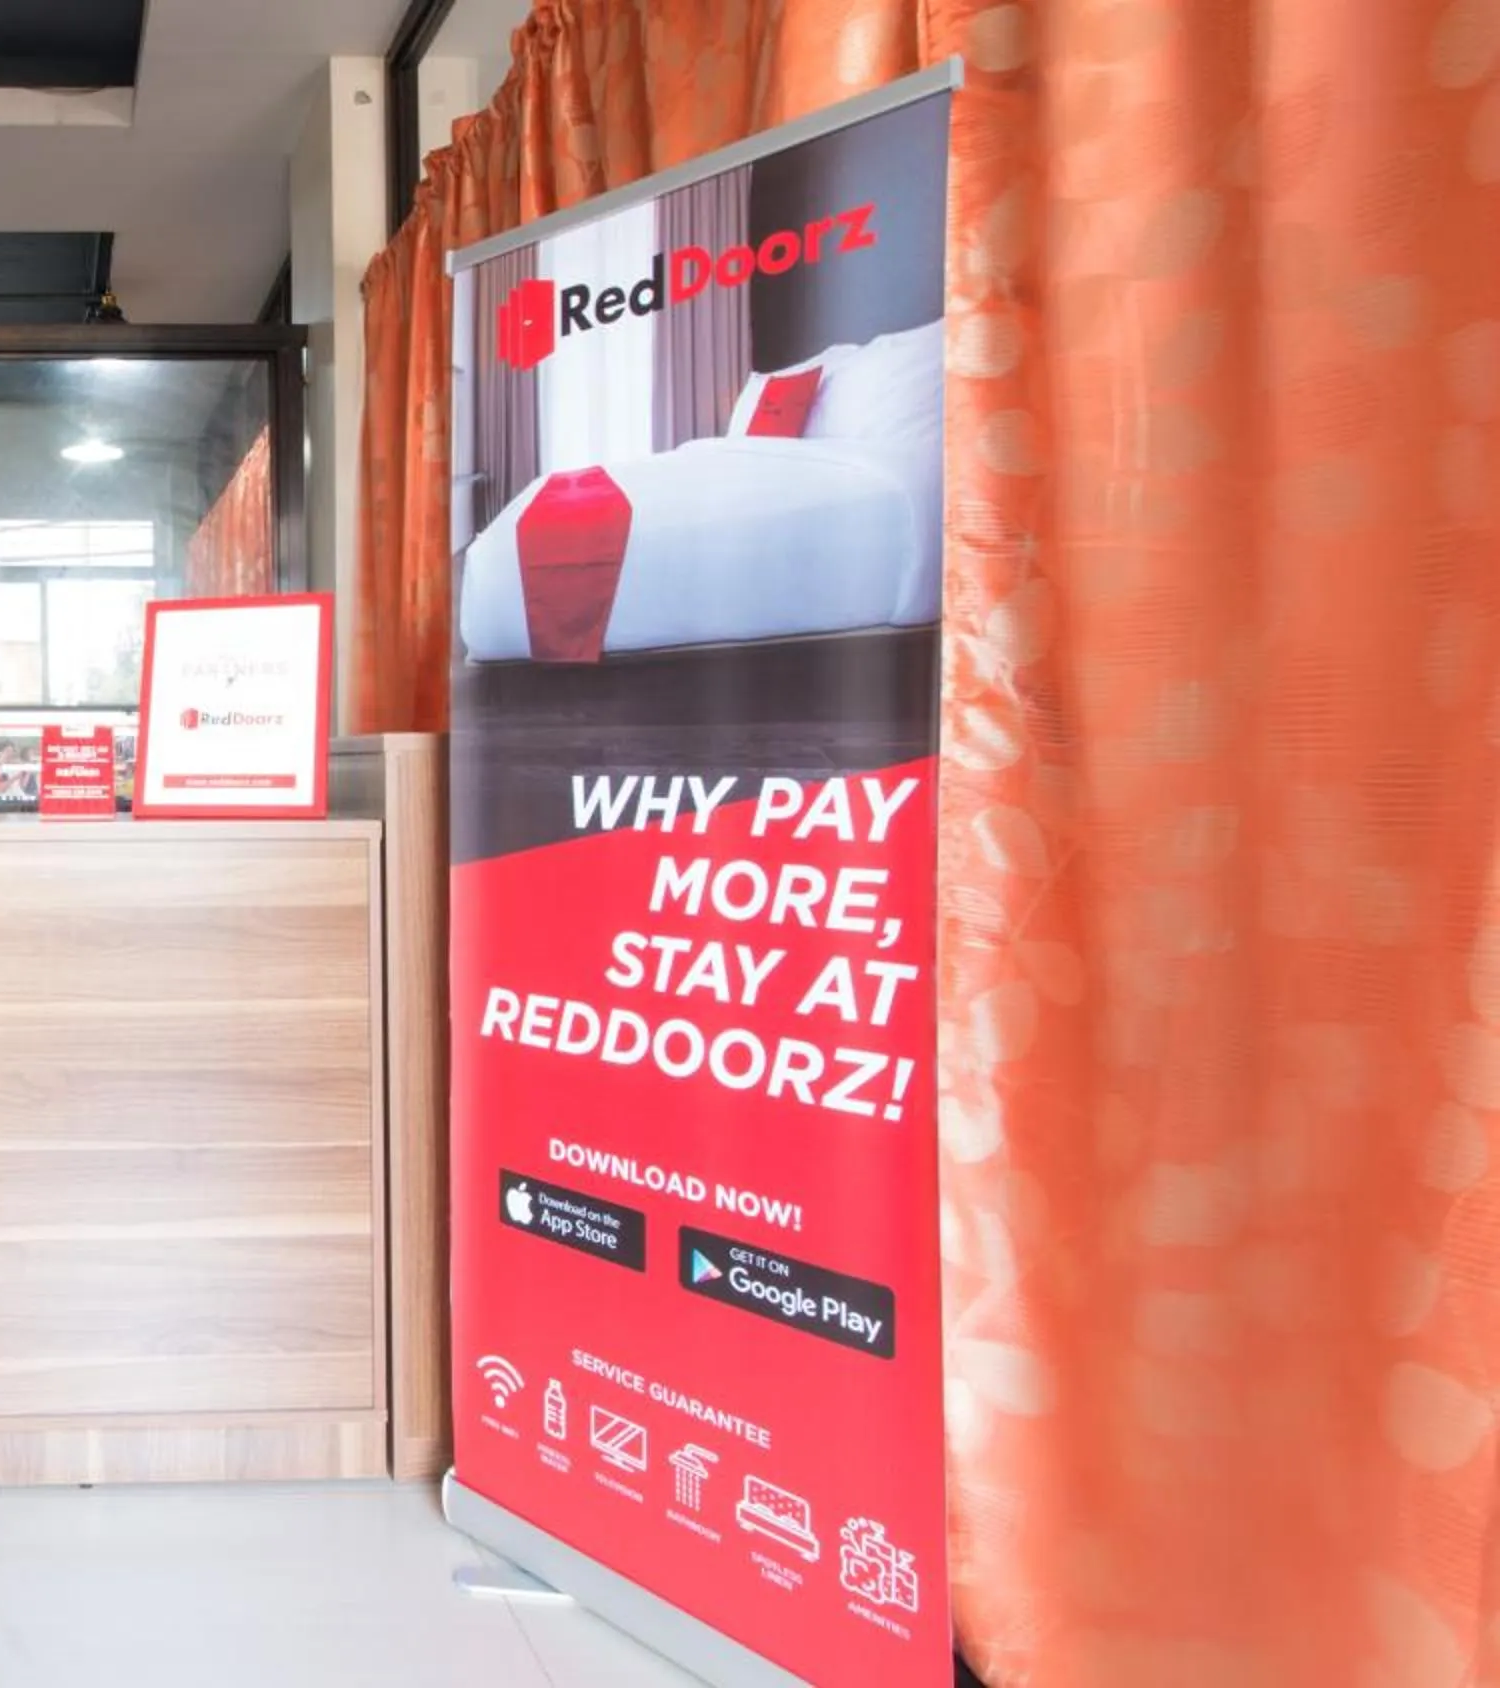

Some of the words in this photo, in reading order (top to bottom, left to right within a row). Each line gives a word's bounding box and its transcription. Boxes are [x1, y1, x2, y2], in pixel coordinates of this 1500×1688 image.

[559, 202, 877, 338] RedDoorz
[201, 711, 284, 726] RedDoorz
[572, 774, 737, 835] WHY
[751, 777, 919, 843] PAY
[648, 856, 904, 949] MORE,
[604, 931, 786, 1006] STAY
[796, 956, 917, 1027] AT
[480, 987, 915, 1123] REDDOORZ!
[538, 1191, 587, 1218] Download
[587, 1211, 601, 1222] on
[603, 1213, 620, 1229] the
[549, 1138, 706, 1203] DOWNLOAD
[715, 1183, 802, 1232] NOW!
[541, 1209, 573, 1237] App
[575, 1219, 618, 1249] Store
[729, 1247, 753, 1265] GET
[756, 1256, 767, 1269] IT
[768, 1260, 790, 1277] ON
[729, 1266, 817, 1316] Google
[822, 1296, 882, 1343] Play
[572, 1348, 645, 1394] SERVICE
[649, 1381, 772, 1449] GUARANTEE
